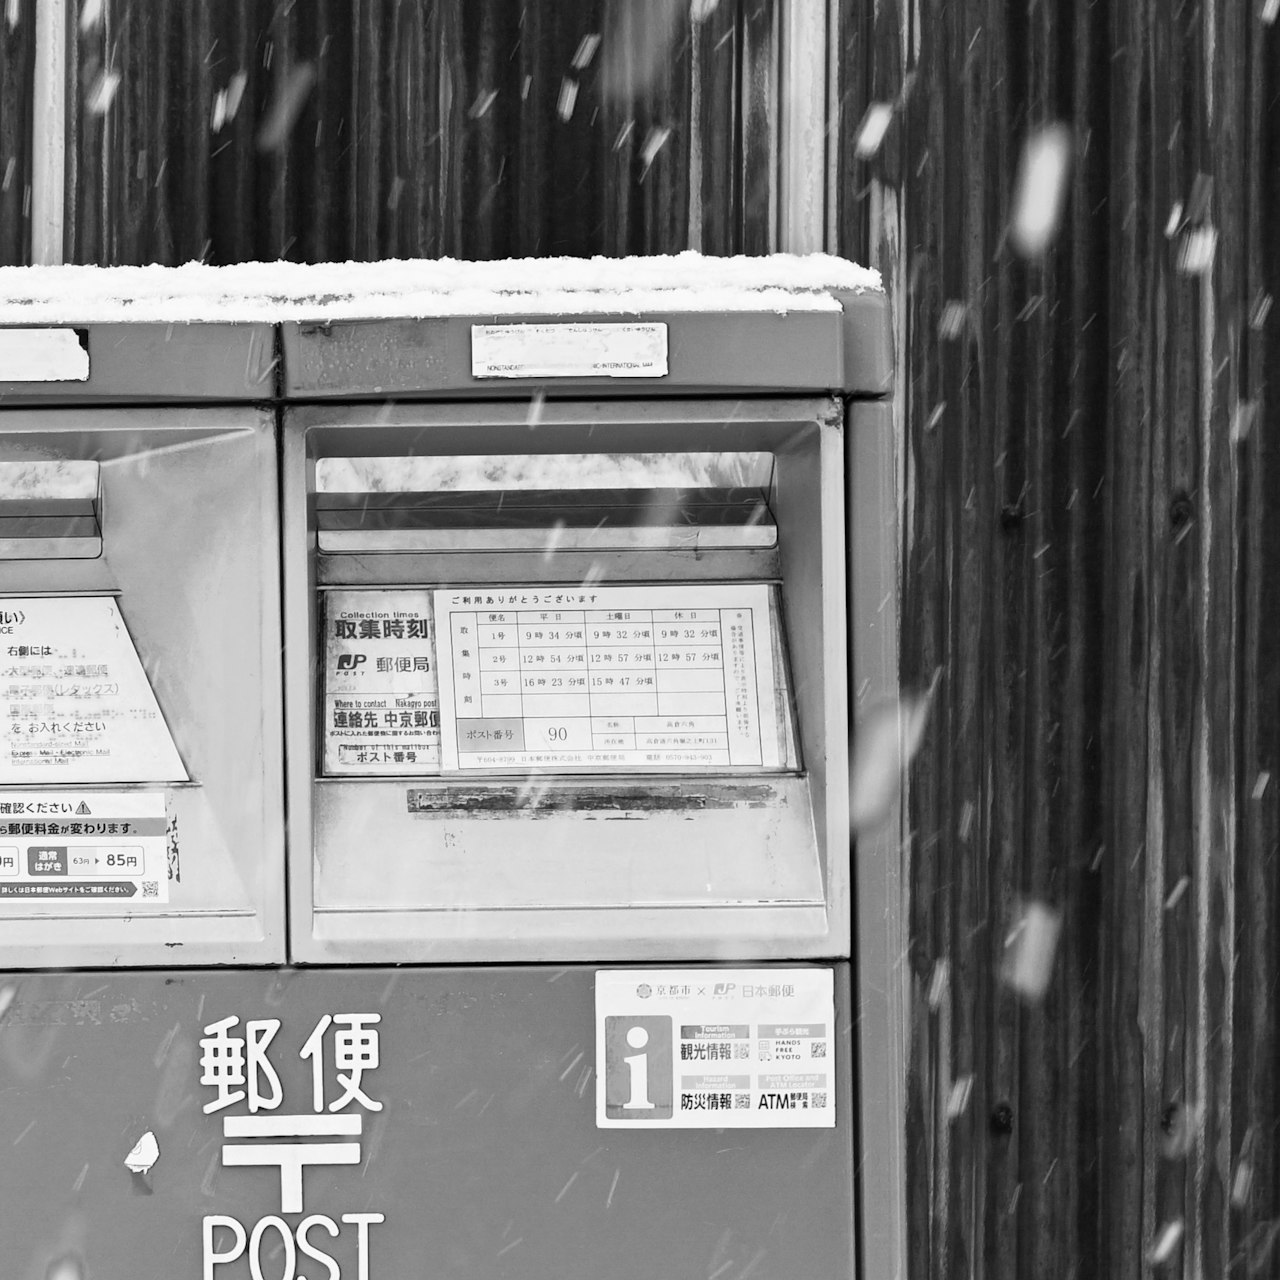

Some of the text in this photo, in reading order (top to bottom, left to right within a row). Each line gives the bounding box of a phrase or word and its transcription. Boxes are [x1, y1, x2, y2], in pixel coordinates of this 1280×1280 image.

[451, 595, 598, 605] ご利用ありがとうございます
[340, 611, 390, 619] Collection
[606, 611, 631, 620] 土曜日
[335, 619, 429, 640] 取集時刻
[491, 631, 506, 640] 1号
[7, 645, 52, 657] 右側には
[376, 656, 430, 673] 郵便局
[492, 655, 507, 663] 2号
[493, 678, 508, 687] 3号
[334, 699, 353, 708] Where
[355, 700, 362, 708] to
[363, 699, 387, 708] contact
[395, 699, 422, 709] Nakagyo
[334, 710, 378, 728] 連絡先
[27, 721, 106, 733] お入れください
[466, 729, 515, 740] ポスト番号
[548, 727, 568, 741] 90
[356, 751, 417, 763] ポスト番号
[38, 851, 58, 861] 通常
[72, 856, 90, 865] 63円
[106, 853, 137, 868] 85円
[34, 860, 62, 872] はがき
[656, 984, 691, 996] 京都市
[742, 984, 795, 998] 日本郵便
[680, 1042, 732, 1061] 観光情報
[199, 1013, 383, 1115] 郵便
[681, 1093, 732, 1110] 防災情報
[758, 1093, 790, 1110] ATM
